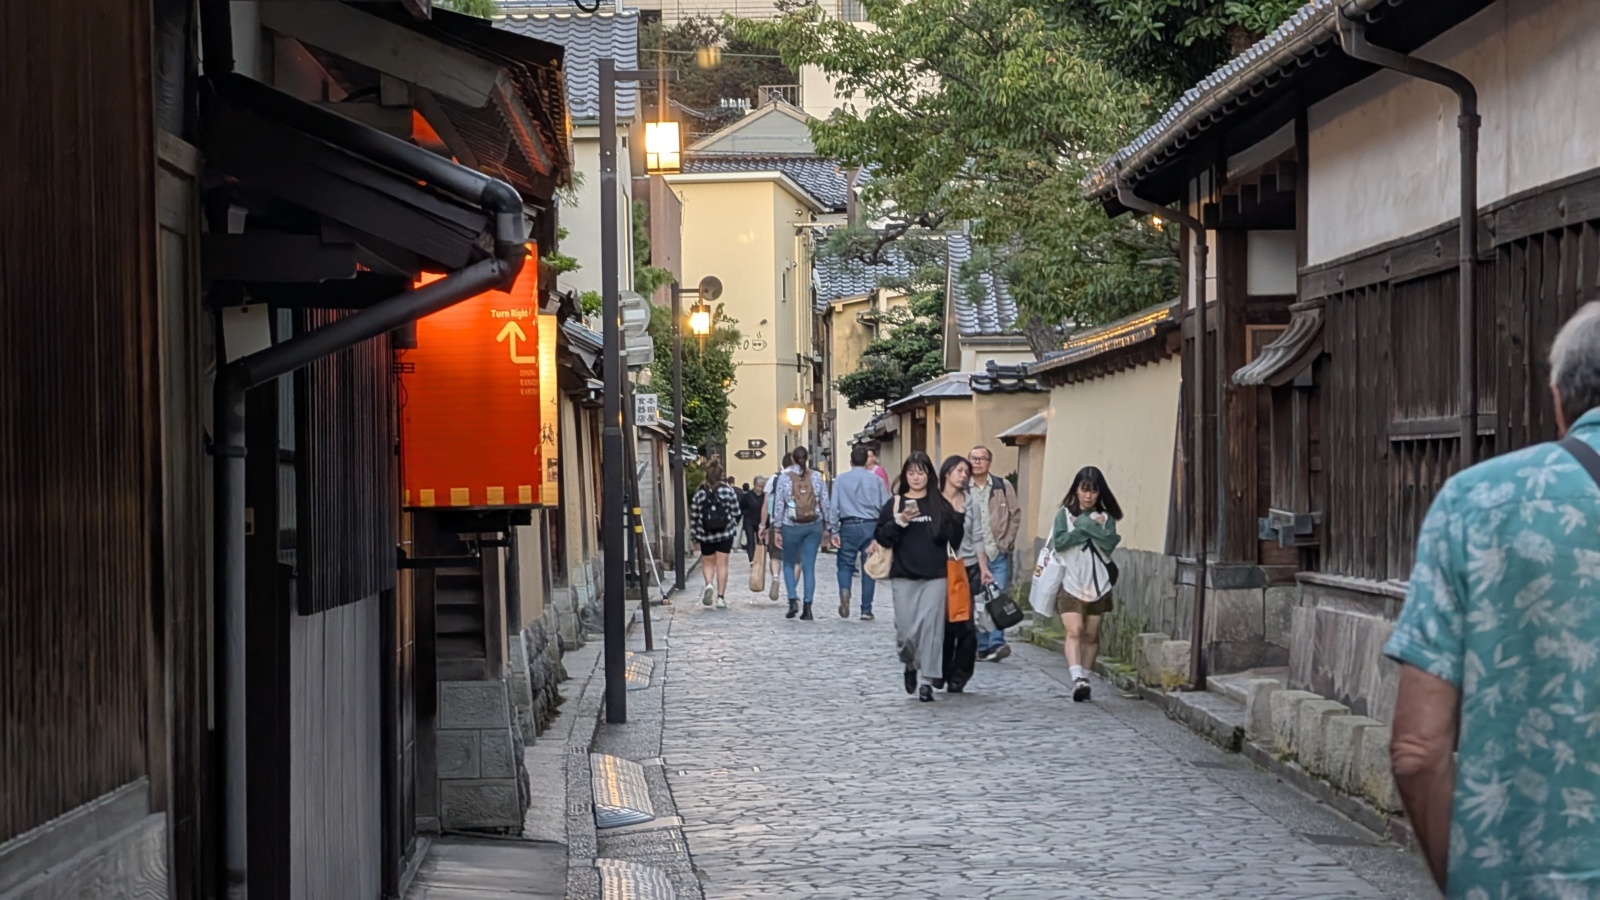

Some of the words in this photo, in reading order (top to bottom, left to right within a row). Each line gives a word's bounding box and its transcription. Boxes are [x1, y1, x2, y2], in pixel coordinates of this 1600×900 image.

[491, 309, 510, 318] Turn
[510, 308, 528, 320] Right
[637, 397, 646, 422] 食器店
[647, 397, 656, 422] 本田屋
